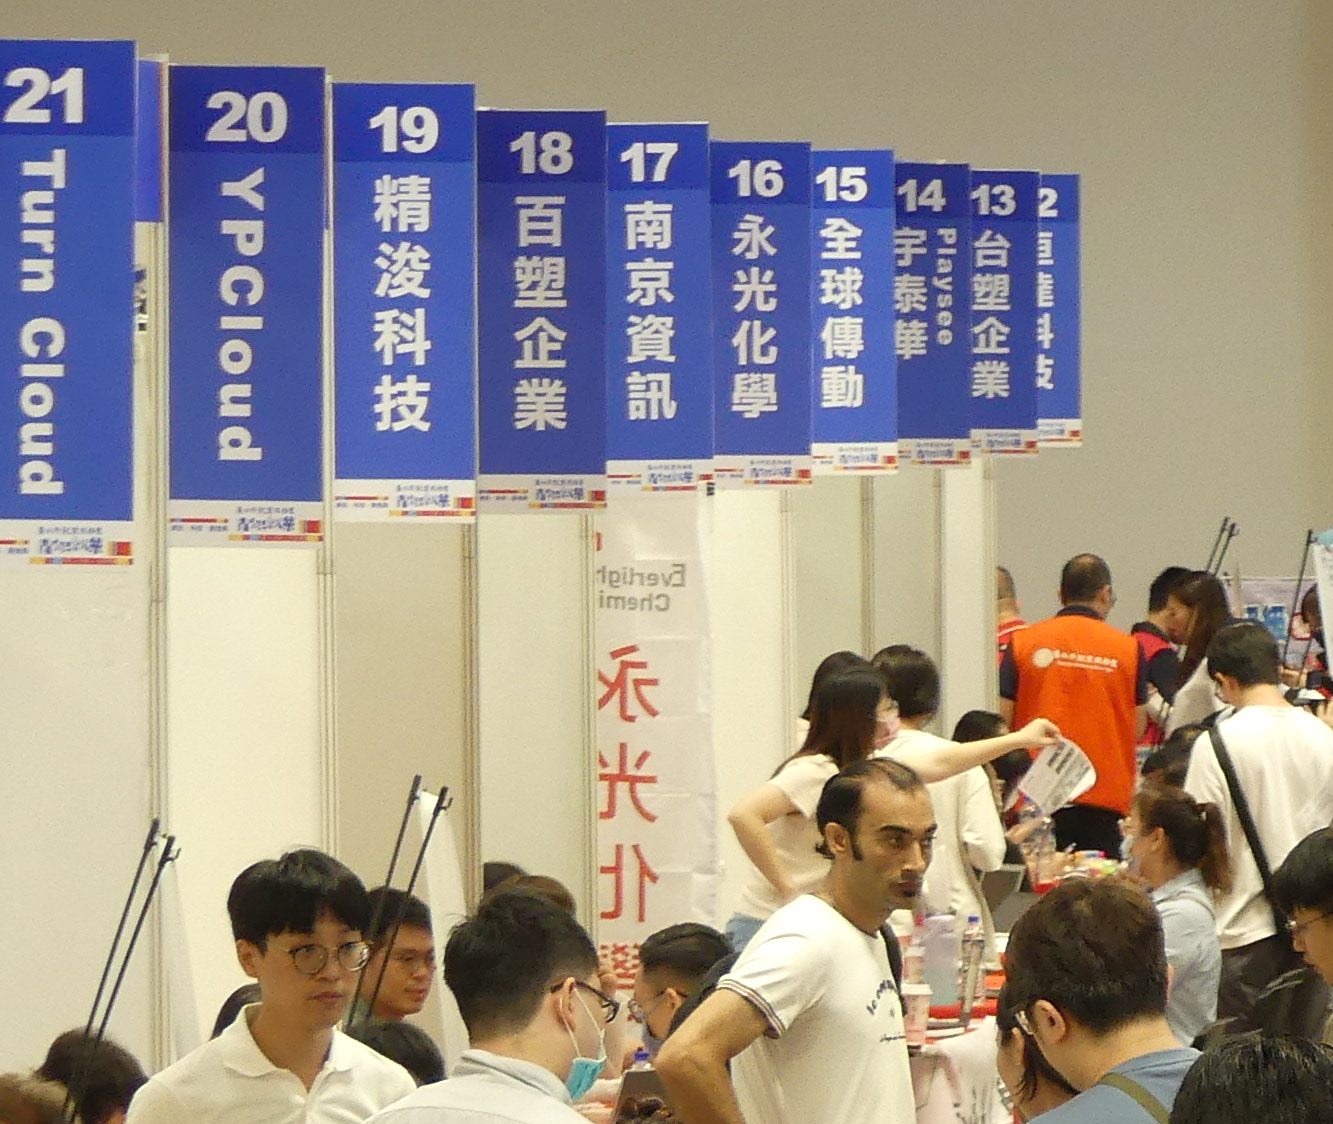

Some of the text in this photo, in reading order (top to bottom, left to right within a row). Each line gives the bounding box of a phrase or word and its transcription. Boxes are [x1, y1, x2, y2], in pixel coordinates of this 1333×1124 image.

[5, 68, 83, 123] 21
[207, 92, 287, 142] 20
[370, 107, 438, 153] 19
[511, 132, 572, 174] 18
[621, 143, 678, 181] 17
[729, 160, 783, 197] 16
[816, 167, 867, 201] 15
[899, 180, 945, 211] 14
[972, 185, 1015, 215] 13
[1038, 187, 1059, 218] 2
[20, 149, 65, 494] Turn Cloud
[219, 169, 264, 460] YPCloud
[373, 175, 431, 431] 精浚科技
[514, 197, 567, 430] 百塑企業
[625, 201, 676, 420] 南京資訊
[732, 214, 778, 418] 永光化學
[820, 218, 864, 408] 全球傳動
[895, 228, 928, 359] 宇泰華
[933, 229, 956, 344] Playsee
[972, 230, 1010, 398] 台塑企業
